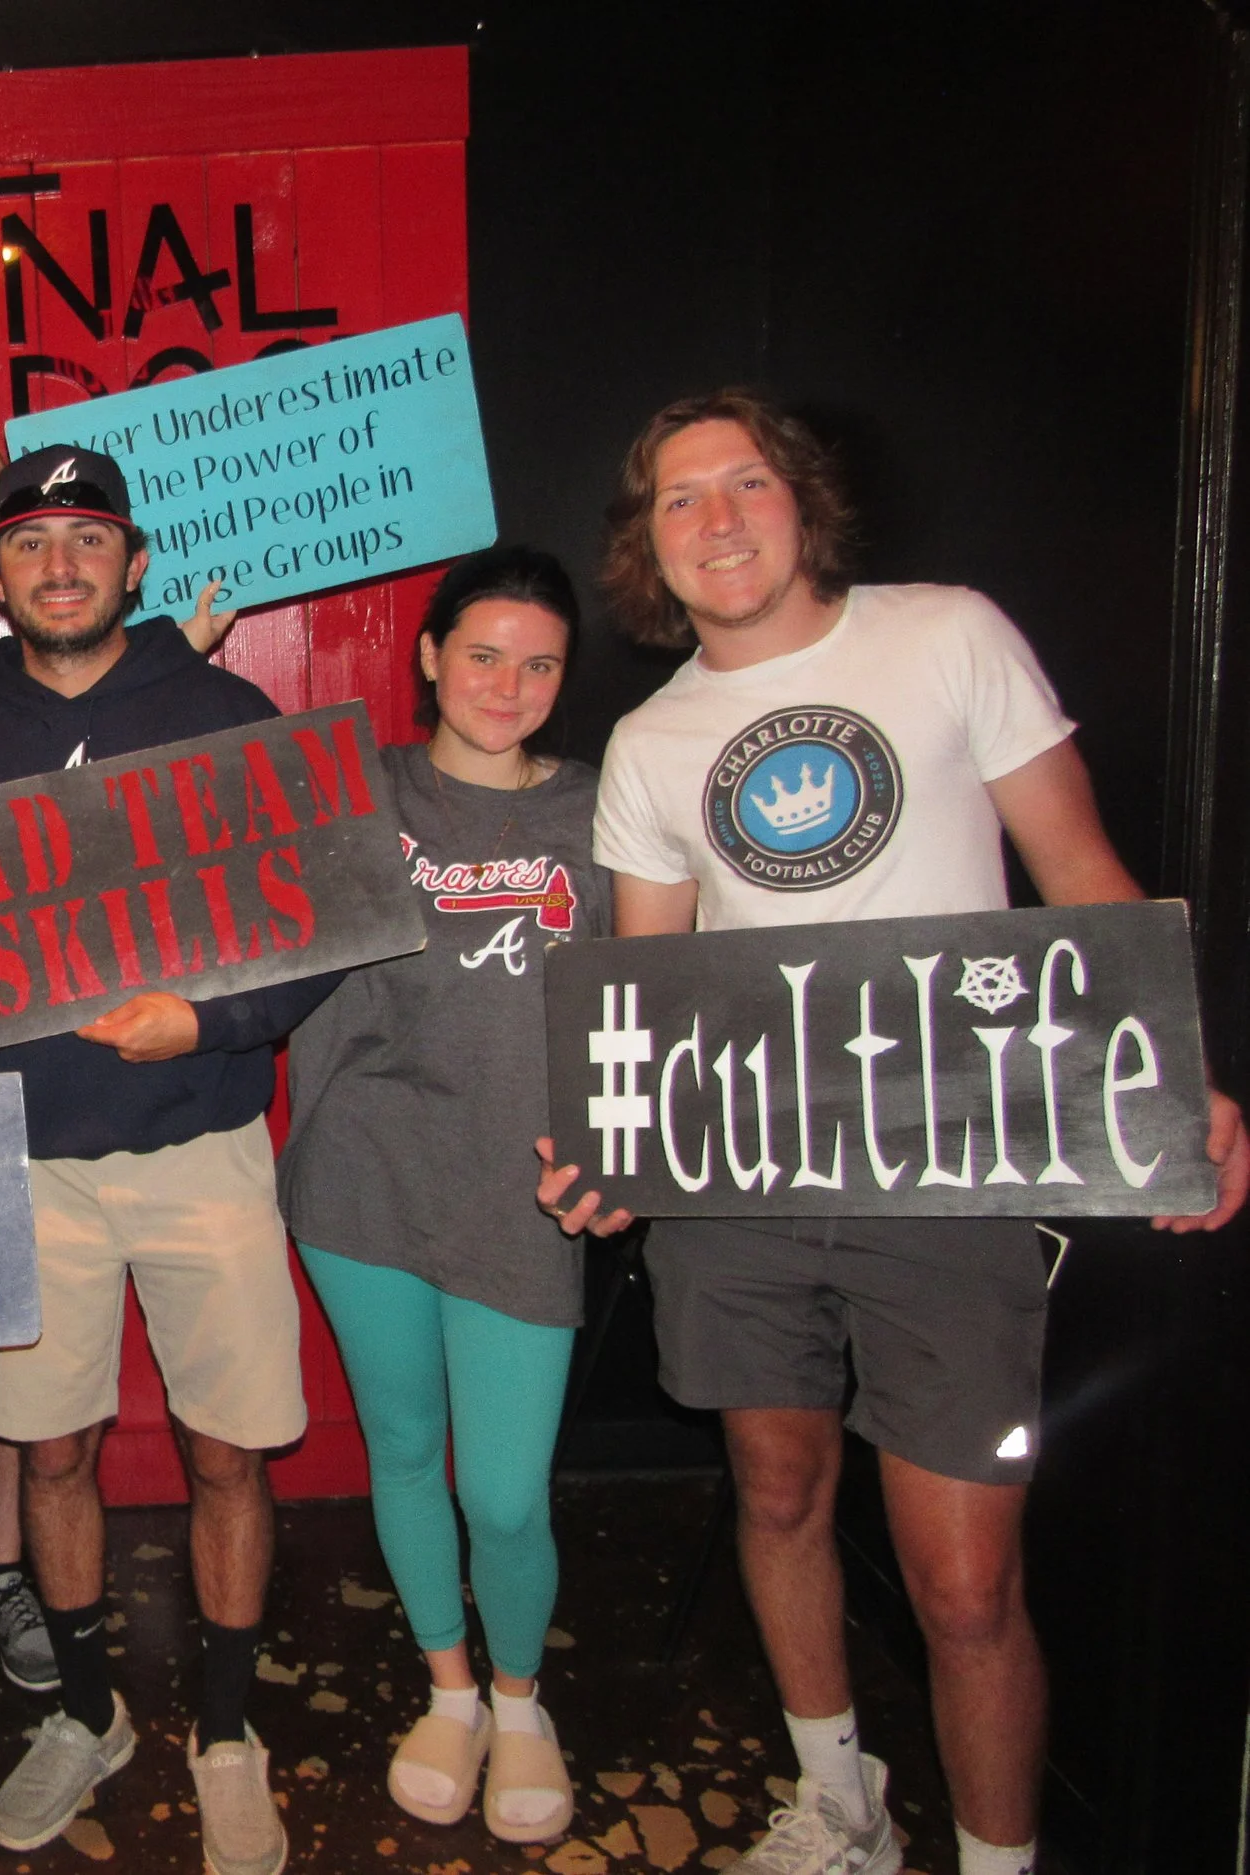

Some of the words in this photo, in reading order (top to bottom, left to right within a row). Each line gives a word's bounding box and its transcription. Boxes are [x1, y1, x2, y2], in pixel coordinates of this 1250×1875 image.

[153, 348, 456, 445] Underestimate
[194, 433, 326, 491] Power
[338, 410, 379, 454] of
[152, 500, 238, 559] upid
[244, 473, 372, 532] People
[378, 465, 413, 498] in
[138, 560, 254, 611] Large
[263, 521, 403, 579] Groups
[717, 716, 859, 788] CHARLOTTE
[104, 717, 377, 870] TEAM
[400, 831, 551, 893] raves
[743, 852, 842, 879] FOOTBALL
[843, 812, 883, 858] CLUB
[460, 916, 526, 976] A
